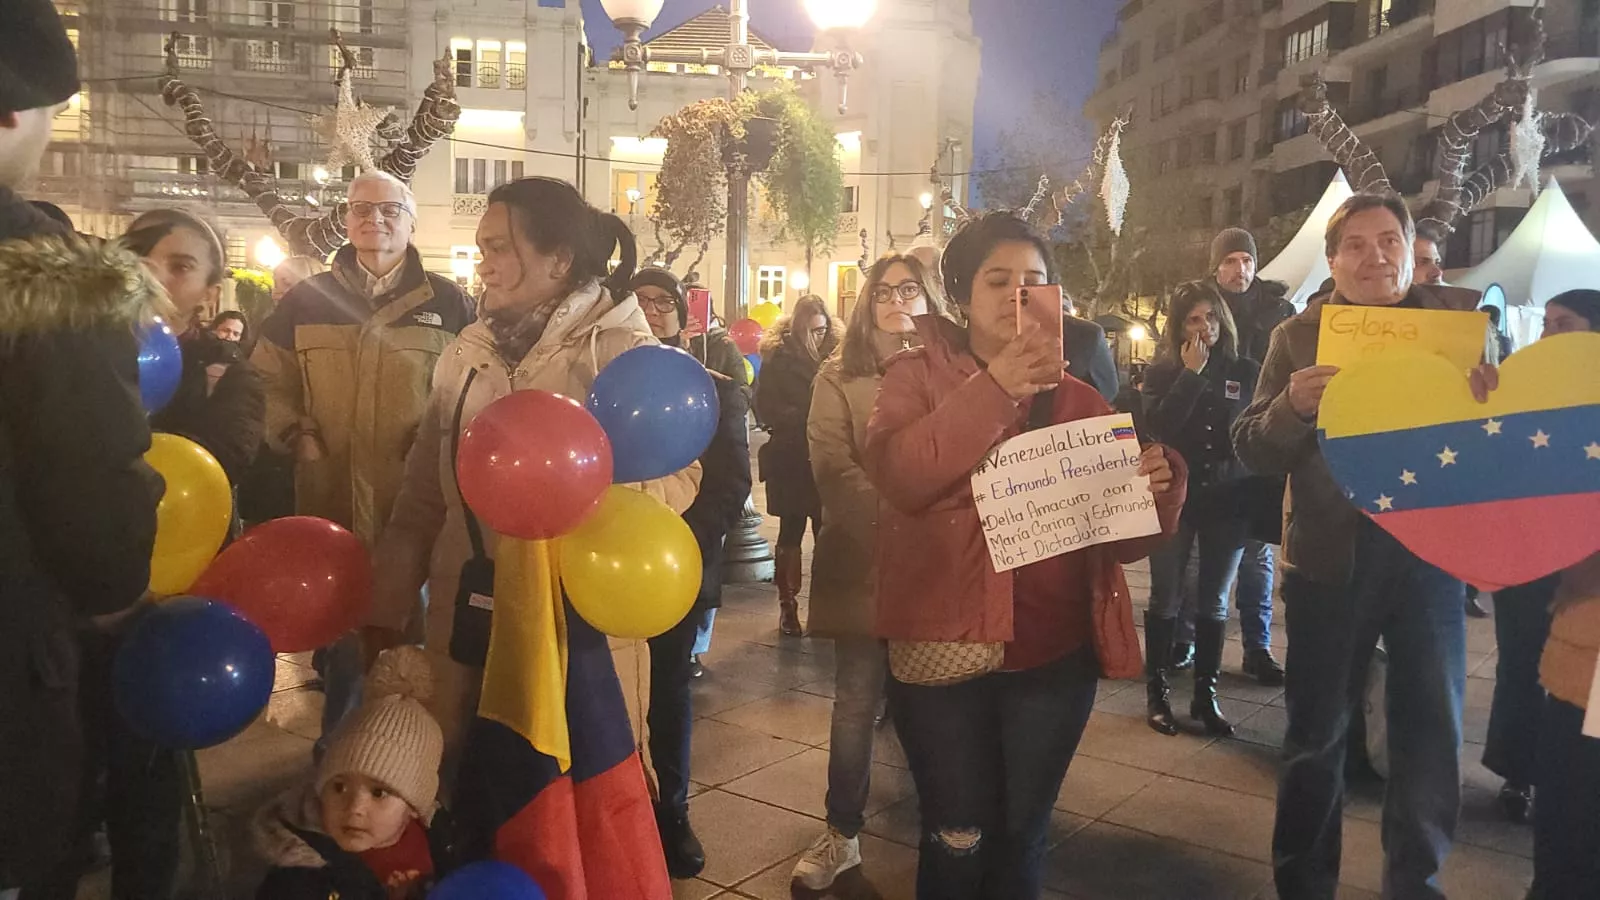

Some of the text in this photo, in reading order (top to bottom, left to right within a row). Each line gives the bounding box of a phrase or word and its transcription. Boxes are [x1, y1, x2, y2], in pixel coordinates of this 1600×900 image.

[991, 469, 1057, 500] Edmundo
[1059, 449, 1141, 480] Presidente
[1026, 492, 1091, 518] Amacuro
[1102, 482, 1133, 498] con
[989, 495, 1155, 553] María Corina y Edmundo
[994, 550, 1014, 567] No
